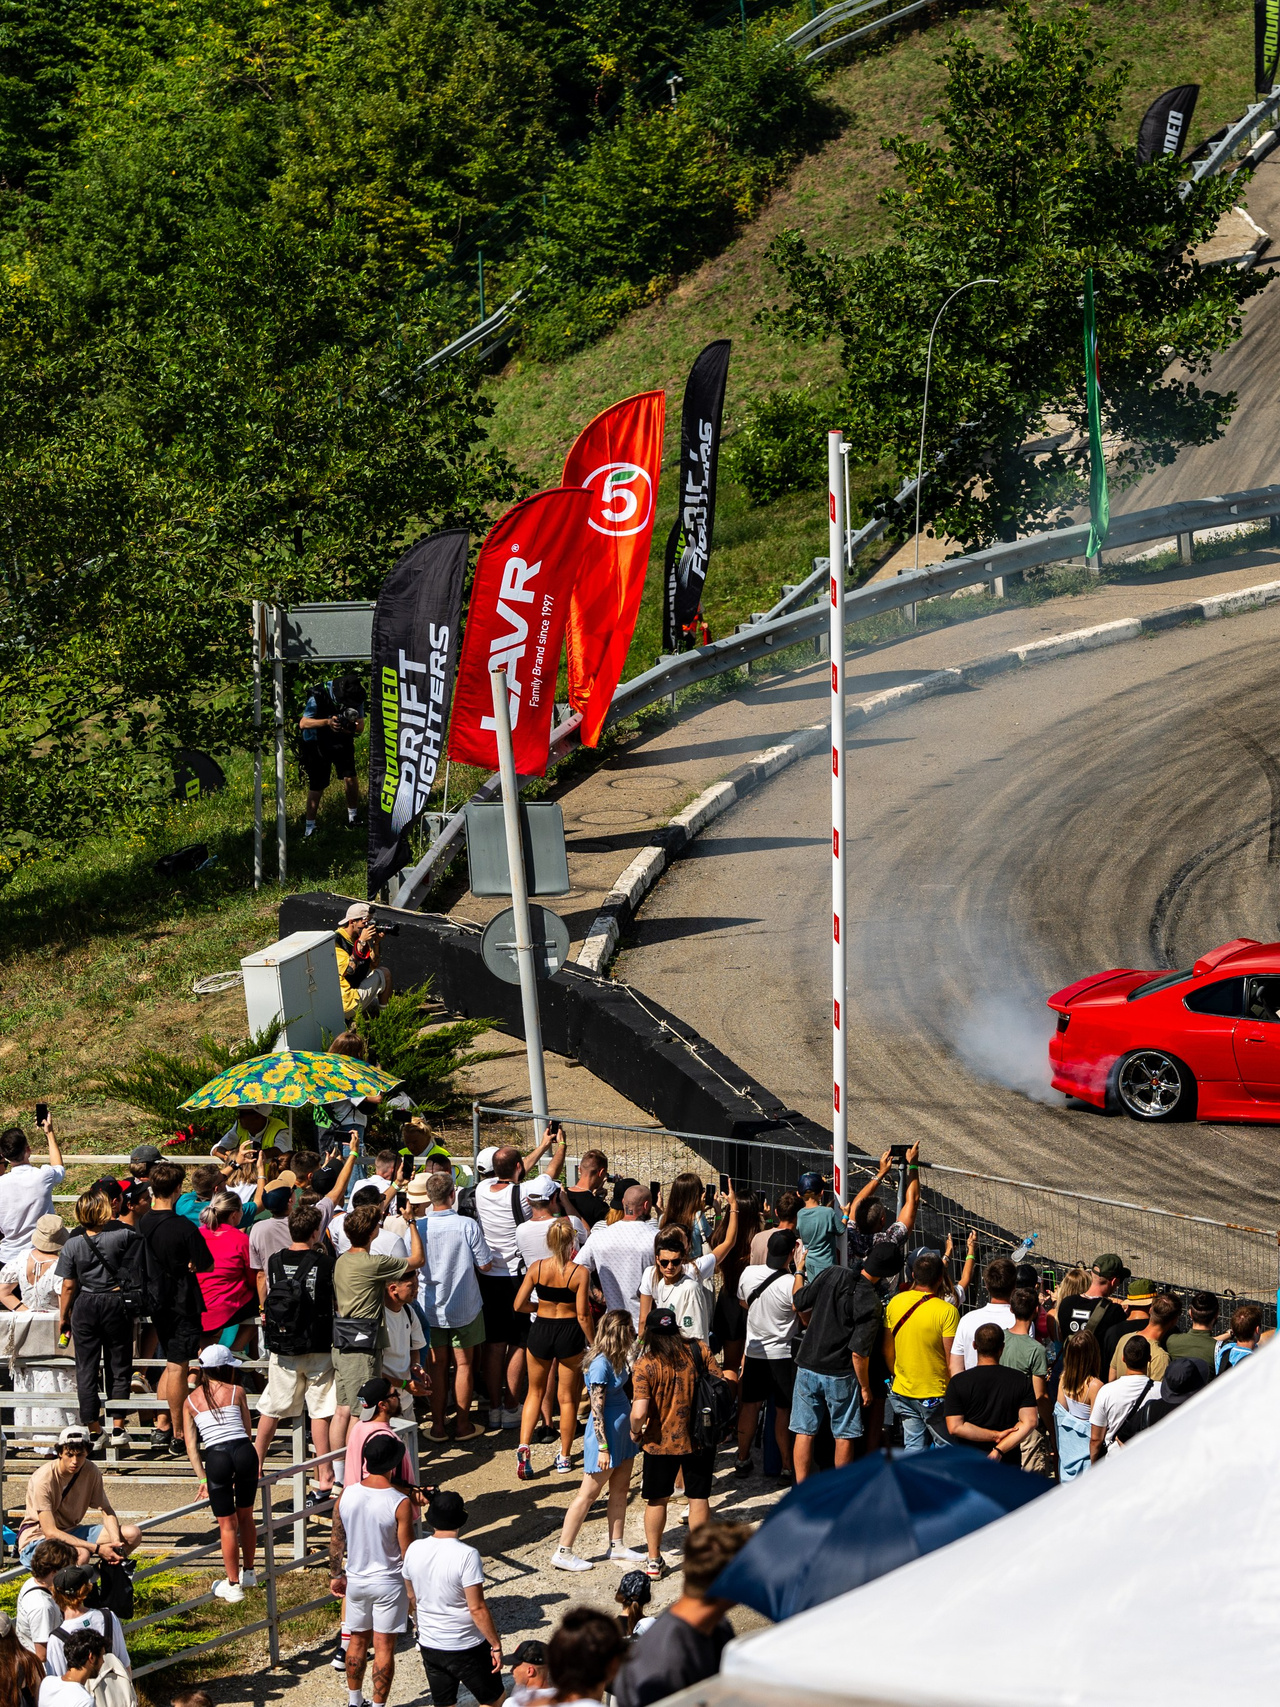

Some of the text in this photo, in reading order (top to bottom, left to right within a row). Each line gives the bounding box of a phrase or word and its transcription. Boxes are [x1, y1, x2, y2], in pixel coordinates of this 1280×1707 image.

[397, 648, 427, 798] DRIFT
[529, 594, 555, 708] Family Brand since 1997
[380, 665, 399, 814] GROUNDED
